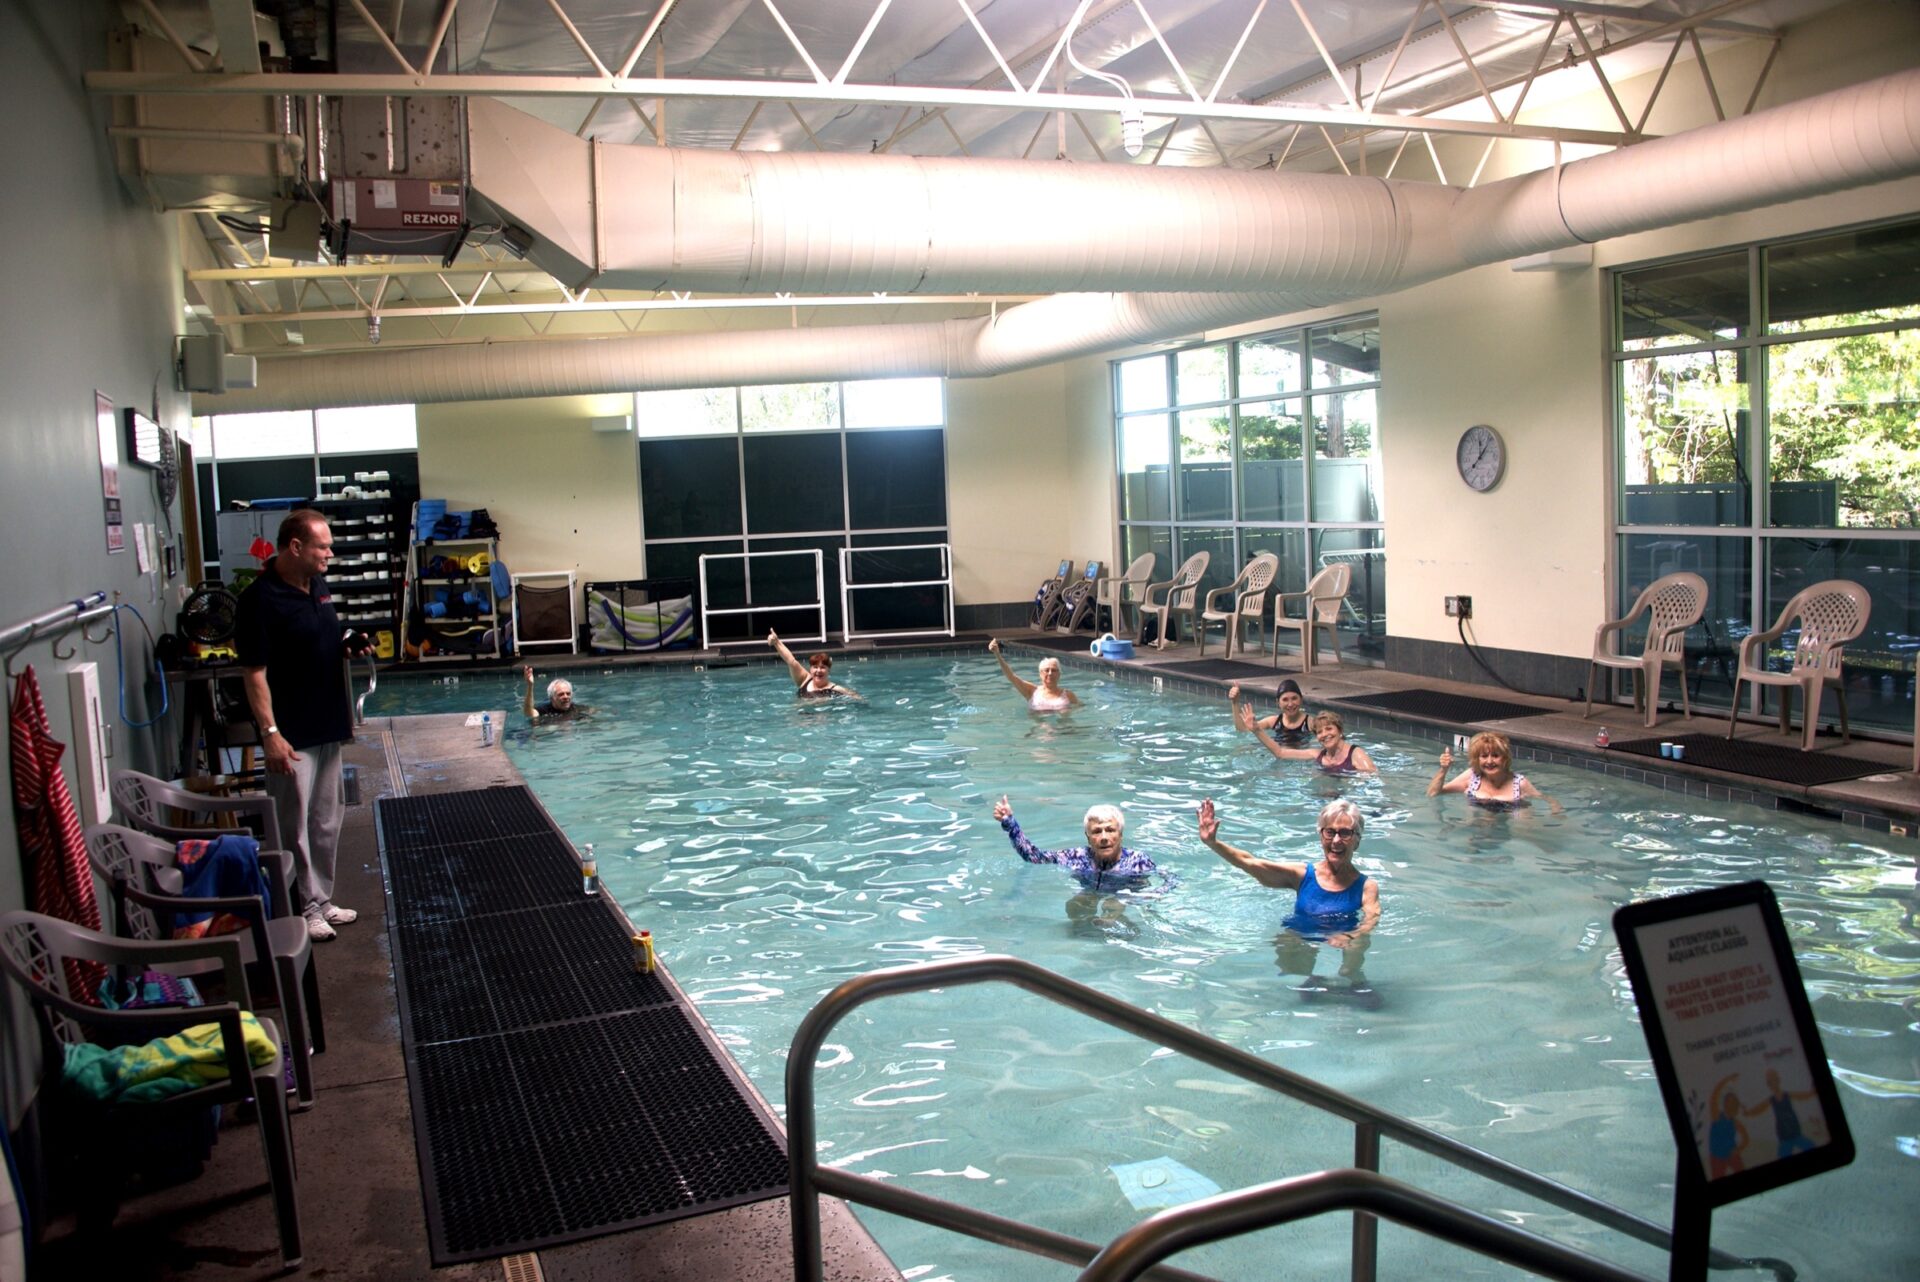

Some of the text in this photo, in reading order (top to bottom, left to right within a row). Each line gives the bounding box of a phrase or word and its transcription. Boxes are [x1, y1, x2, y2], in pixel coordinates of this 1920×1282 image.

[403, 213, 458, 225] REZNOR
[1668, 925, 1740, 949] ATTENTION ALL
[1668, 935, 1749, 963] AQUATIC CLASSES
[1664, 974, 1773, 1010] MINUTES BEFORE CLASS
[1667, 978, 1702, 994] PLEASE
[1702, 971, 1727, 987] WAIT
[1728, 966, 1757, 981] UNTIL
[1675, 1006, 1701, 1020] TIME
[1701, 1003, 1715, 1014] TO
[1715, 995, 1744, 1011] ENTER
